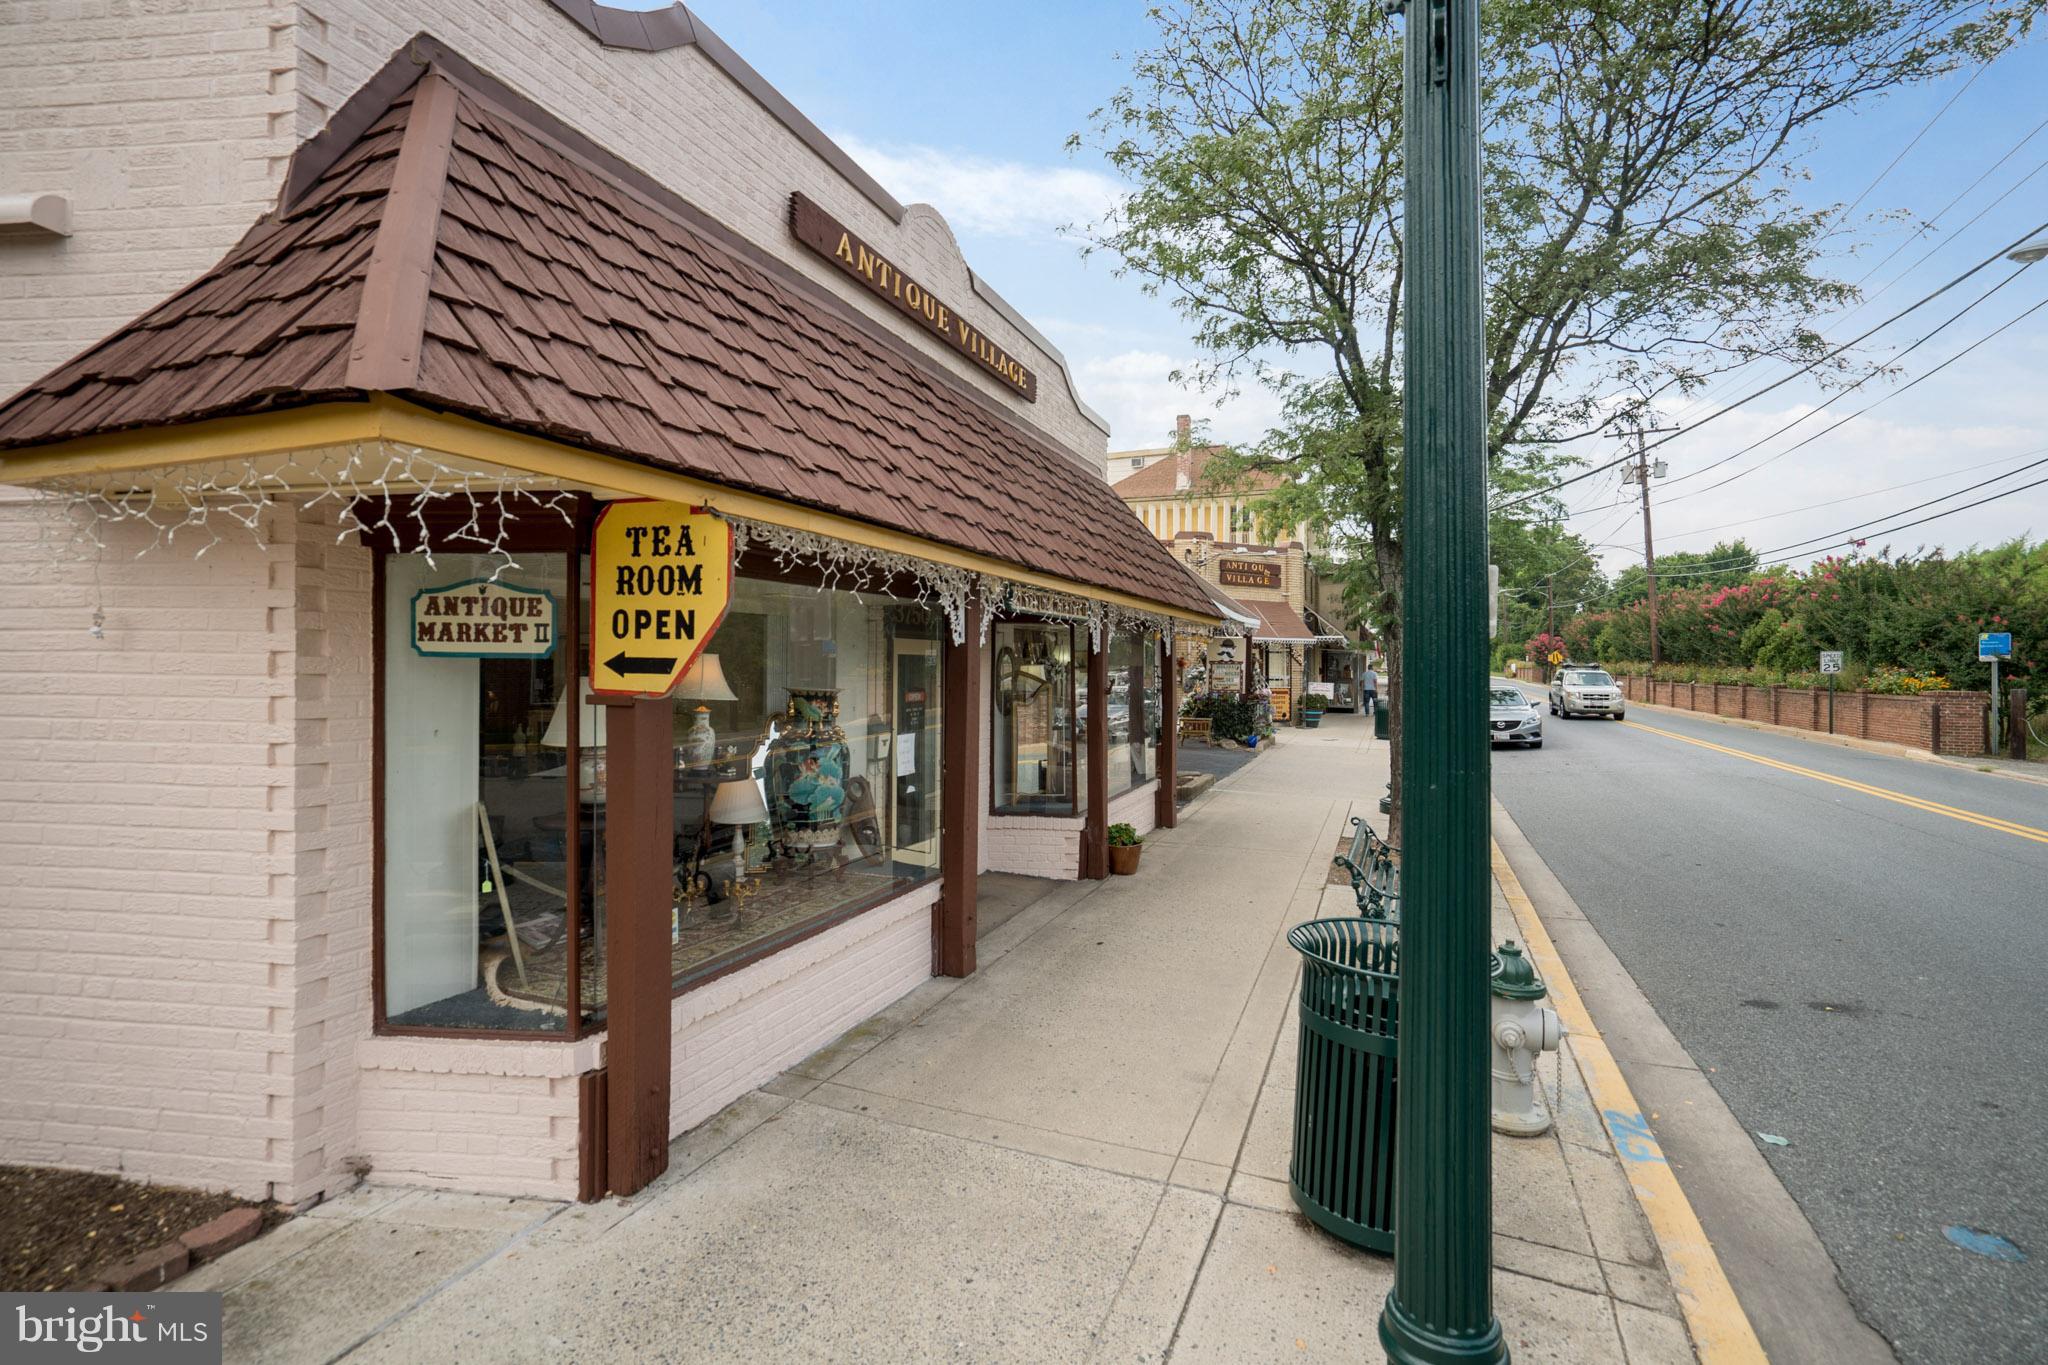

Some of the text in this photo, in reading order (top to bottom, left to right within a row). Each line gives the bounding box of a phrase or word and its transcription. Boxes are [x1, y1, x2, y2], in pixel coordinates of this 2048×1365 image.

[835, 232, 1027, 389] ANTIQUE VILLAGE
[625, 525, 696, 557] TEA
[616, 564, 703, 596] ROOM
[1226, 573, 1270, 585] VILLAGE
[424, 596, 543, 621] ANTIQUE
[417, 622, 550, 643] MARKET II
[612, 609, 695, 640] OPEN
[1823, 664, 1840, 672] 25
